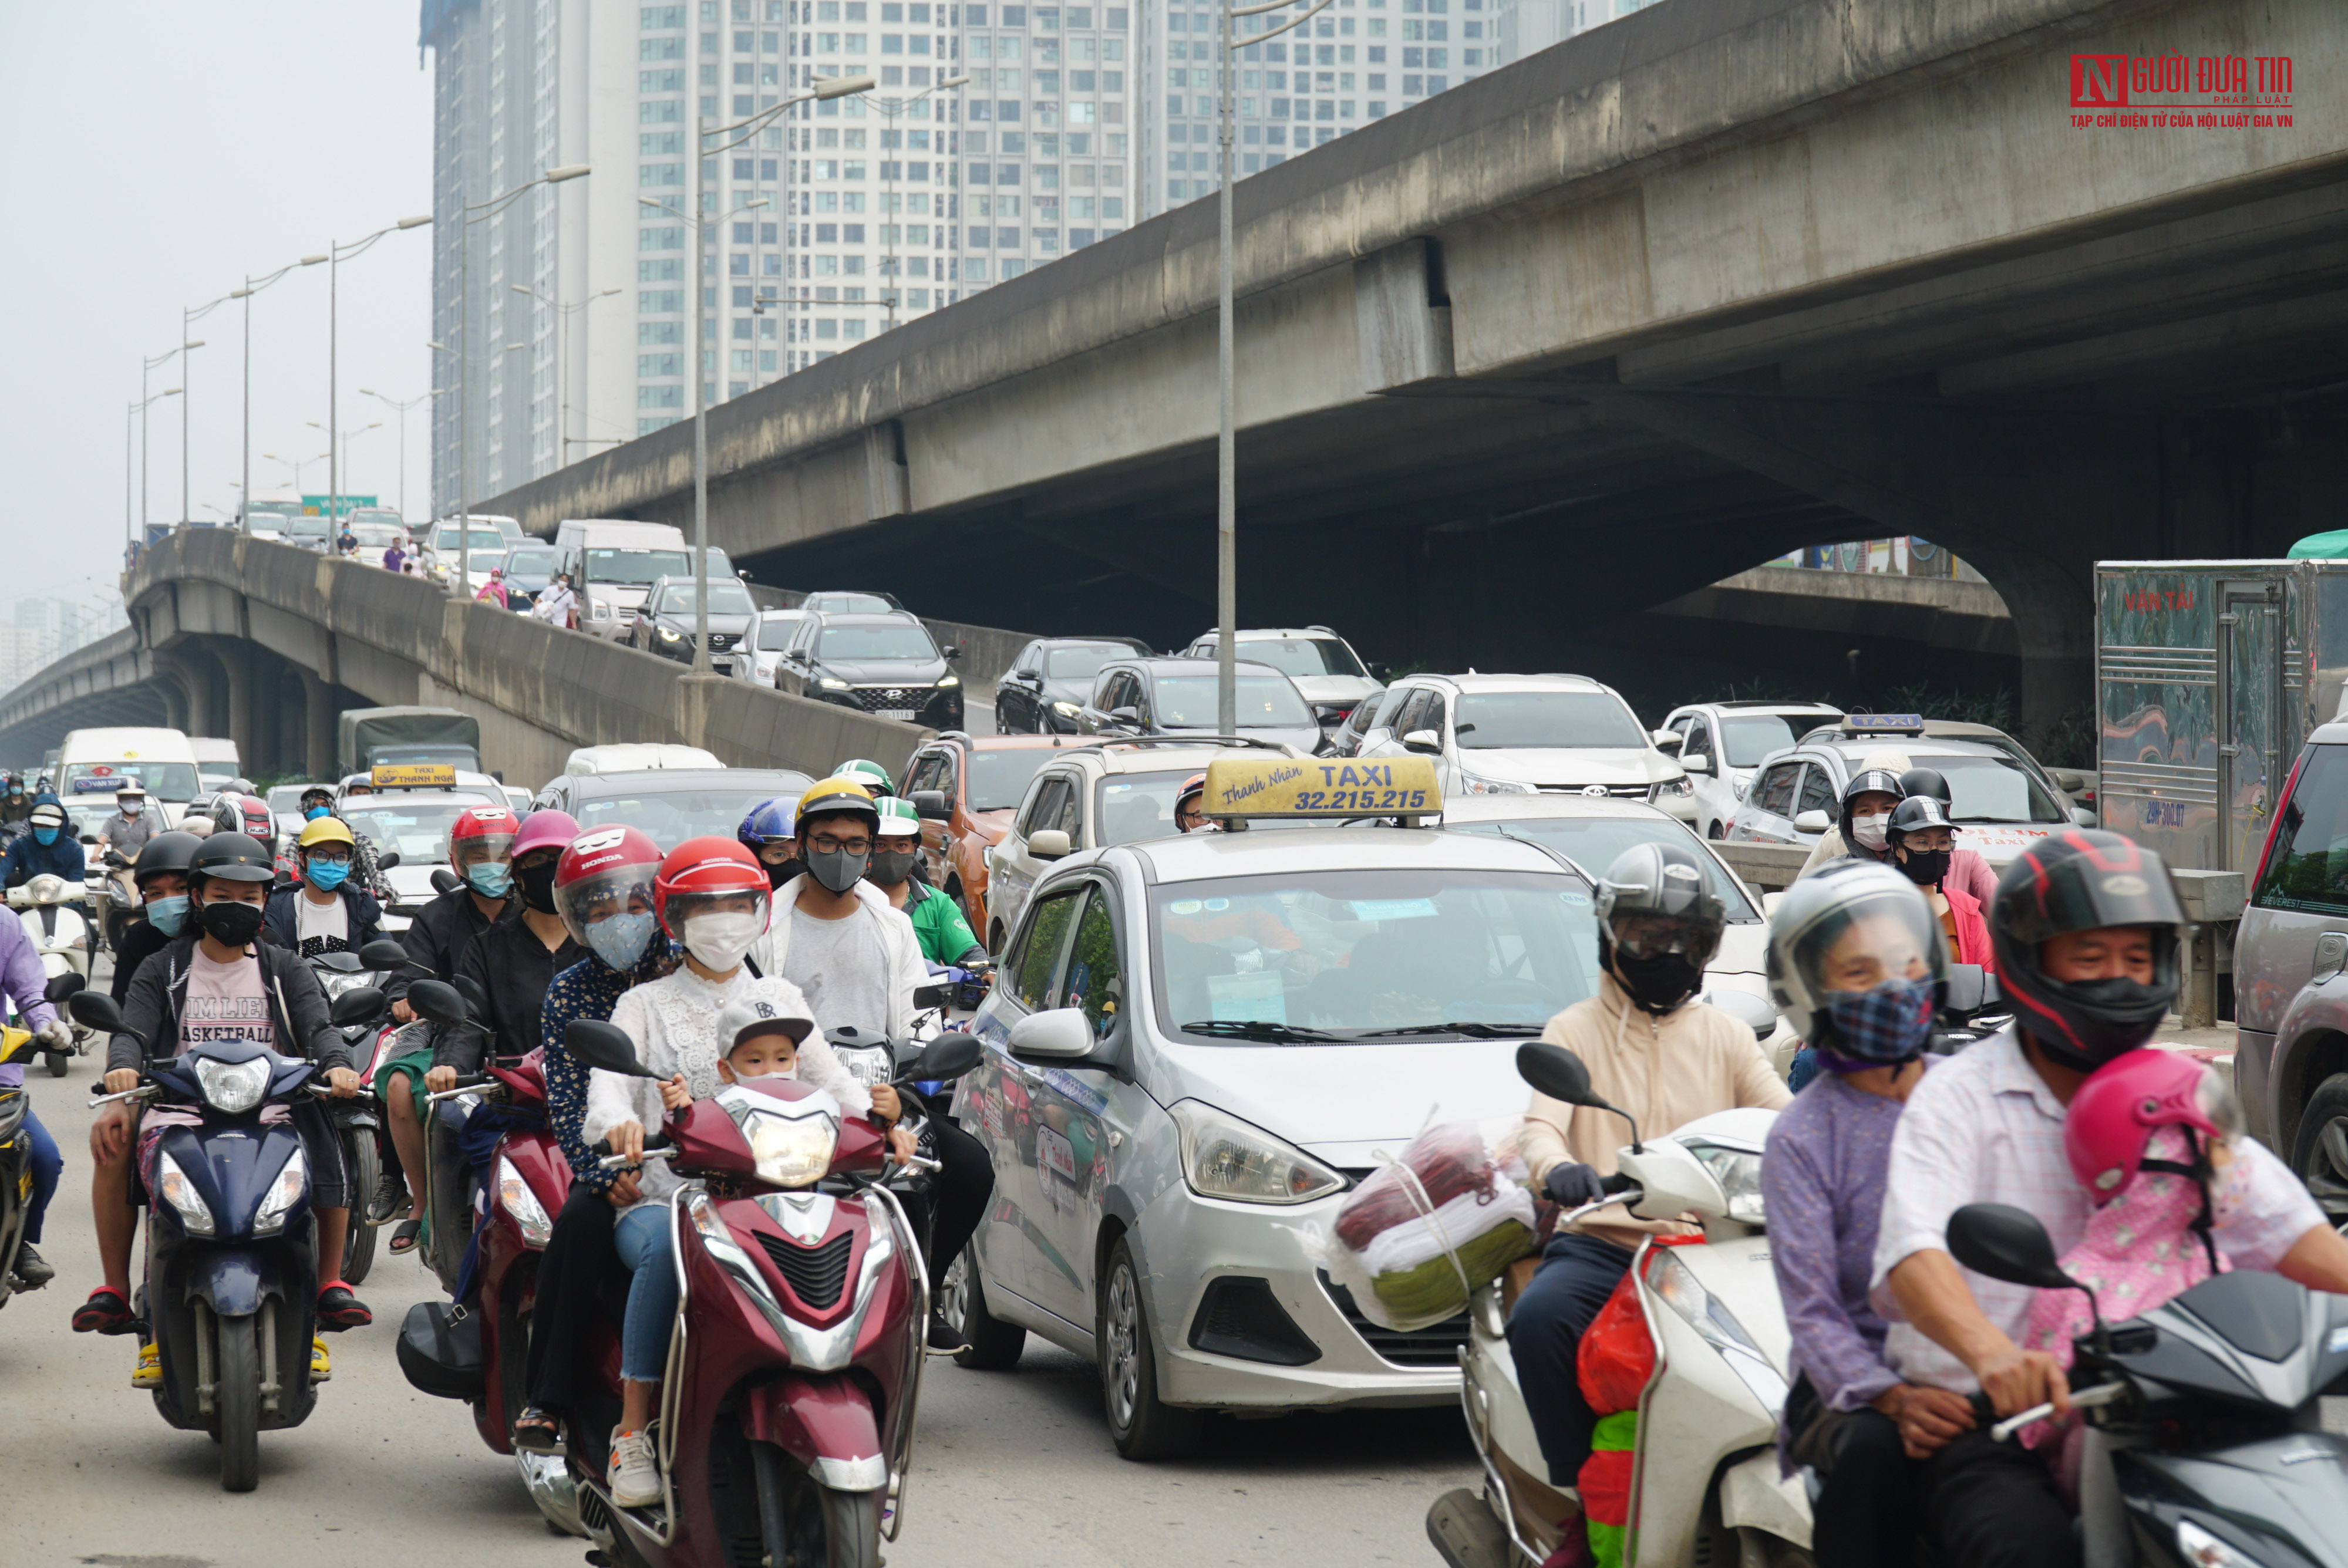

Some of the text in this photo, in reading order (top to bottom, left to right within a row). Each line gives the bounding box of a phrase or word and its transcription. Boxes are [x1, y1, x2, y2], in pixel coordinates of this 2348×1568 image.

[2124, 582, 2194, 615] VẬN TẢI
[1857, 717, 1914, 726] TAXI
[1319, 765, 1392, 787] TAXI
[1222, 766, 1303, 805] Thanh Nhàn
[1294, 790, 1426, 810] 32.215.215
[2146, 801, 2185, 827] 29H-300.07
[1997, 828, 2050, 837] LIM
[1978, 837, 2027, 845] Taxi
[581, 854, 624, 870] HONDA
[1563, 895, 1588, 903] BM
[2268, 896, 2302, 908] EVEREST
[2316, 959, 2342, 974] EVEREST
